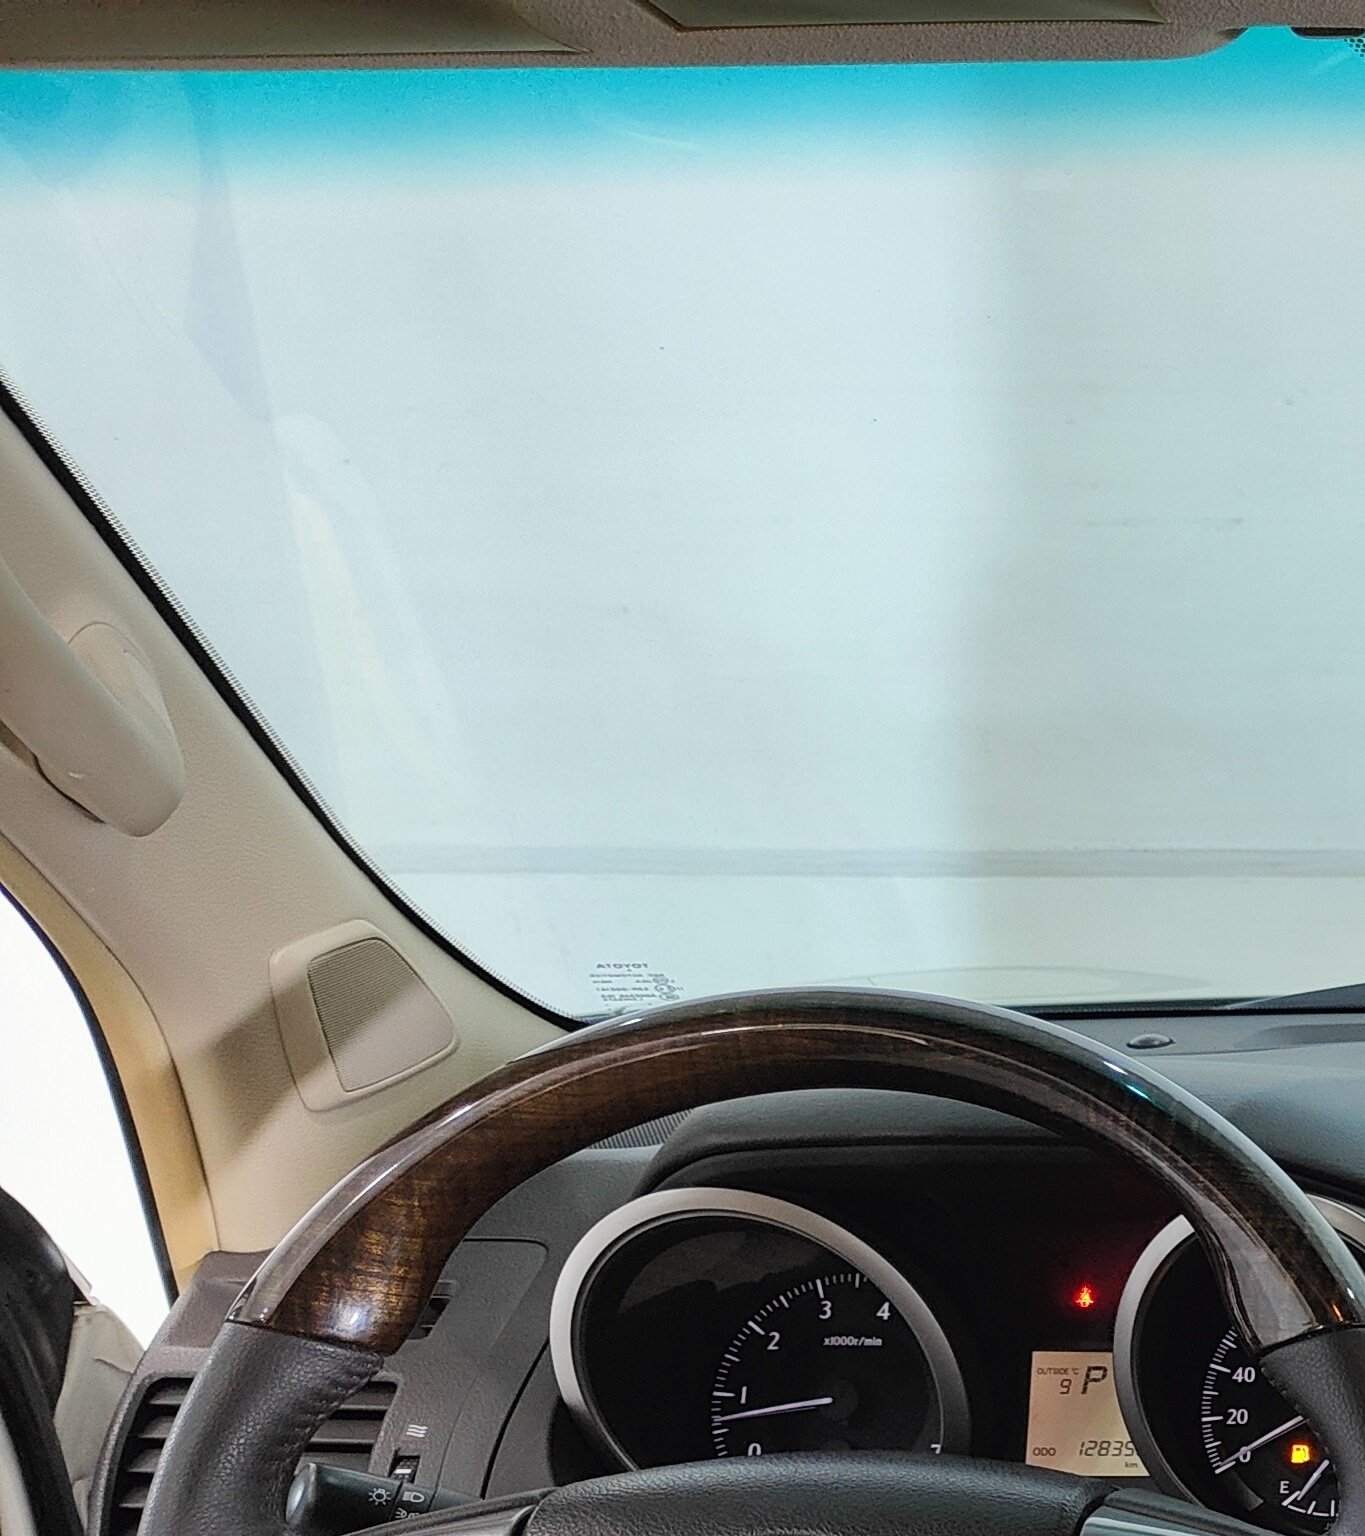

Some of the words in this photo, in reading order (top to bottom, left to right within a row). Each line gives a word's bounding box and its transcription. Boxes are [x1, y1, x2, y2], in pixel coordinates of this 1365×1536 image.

[819, 1300, 832, 1320] 3
[876, 1301, 891, 1320] 4
[767, 1331, 780, 1350] 2
[1081, 1366, 1108, 1395] P
[1232, 1367, 1256, 1383] 40
[1059, 1378, 1072, 1394] 9
[740, 1386, 748, 1404] 1
[1226, 1408, 1249, 1425] 20
[1033, 1447, 1056, 1456] ODO
[1279, 1481, 1290, 1494] E
